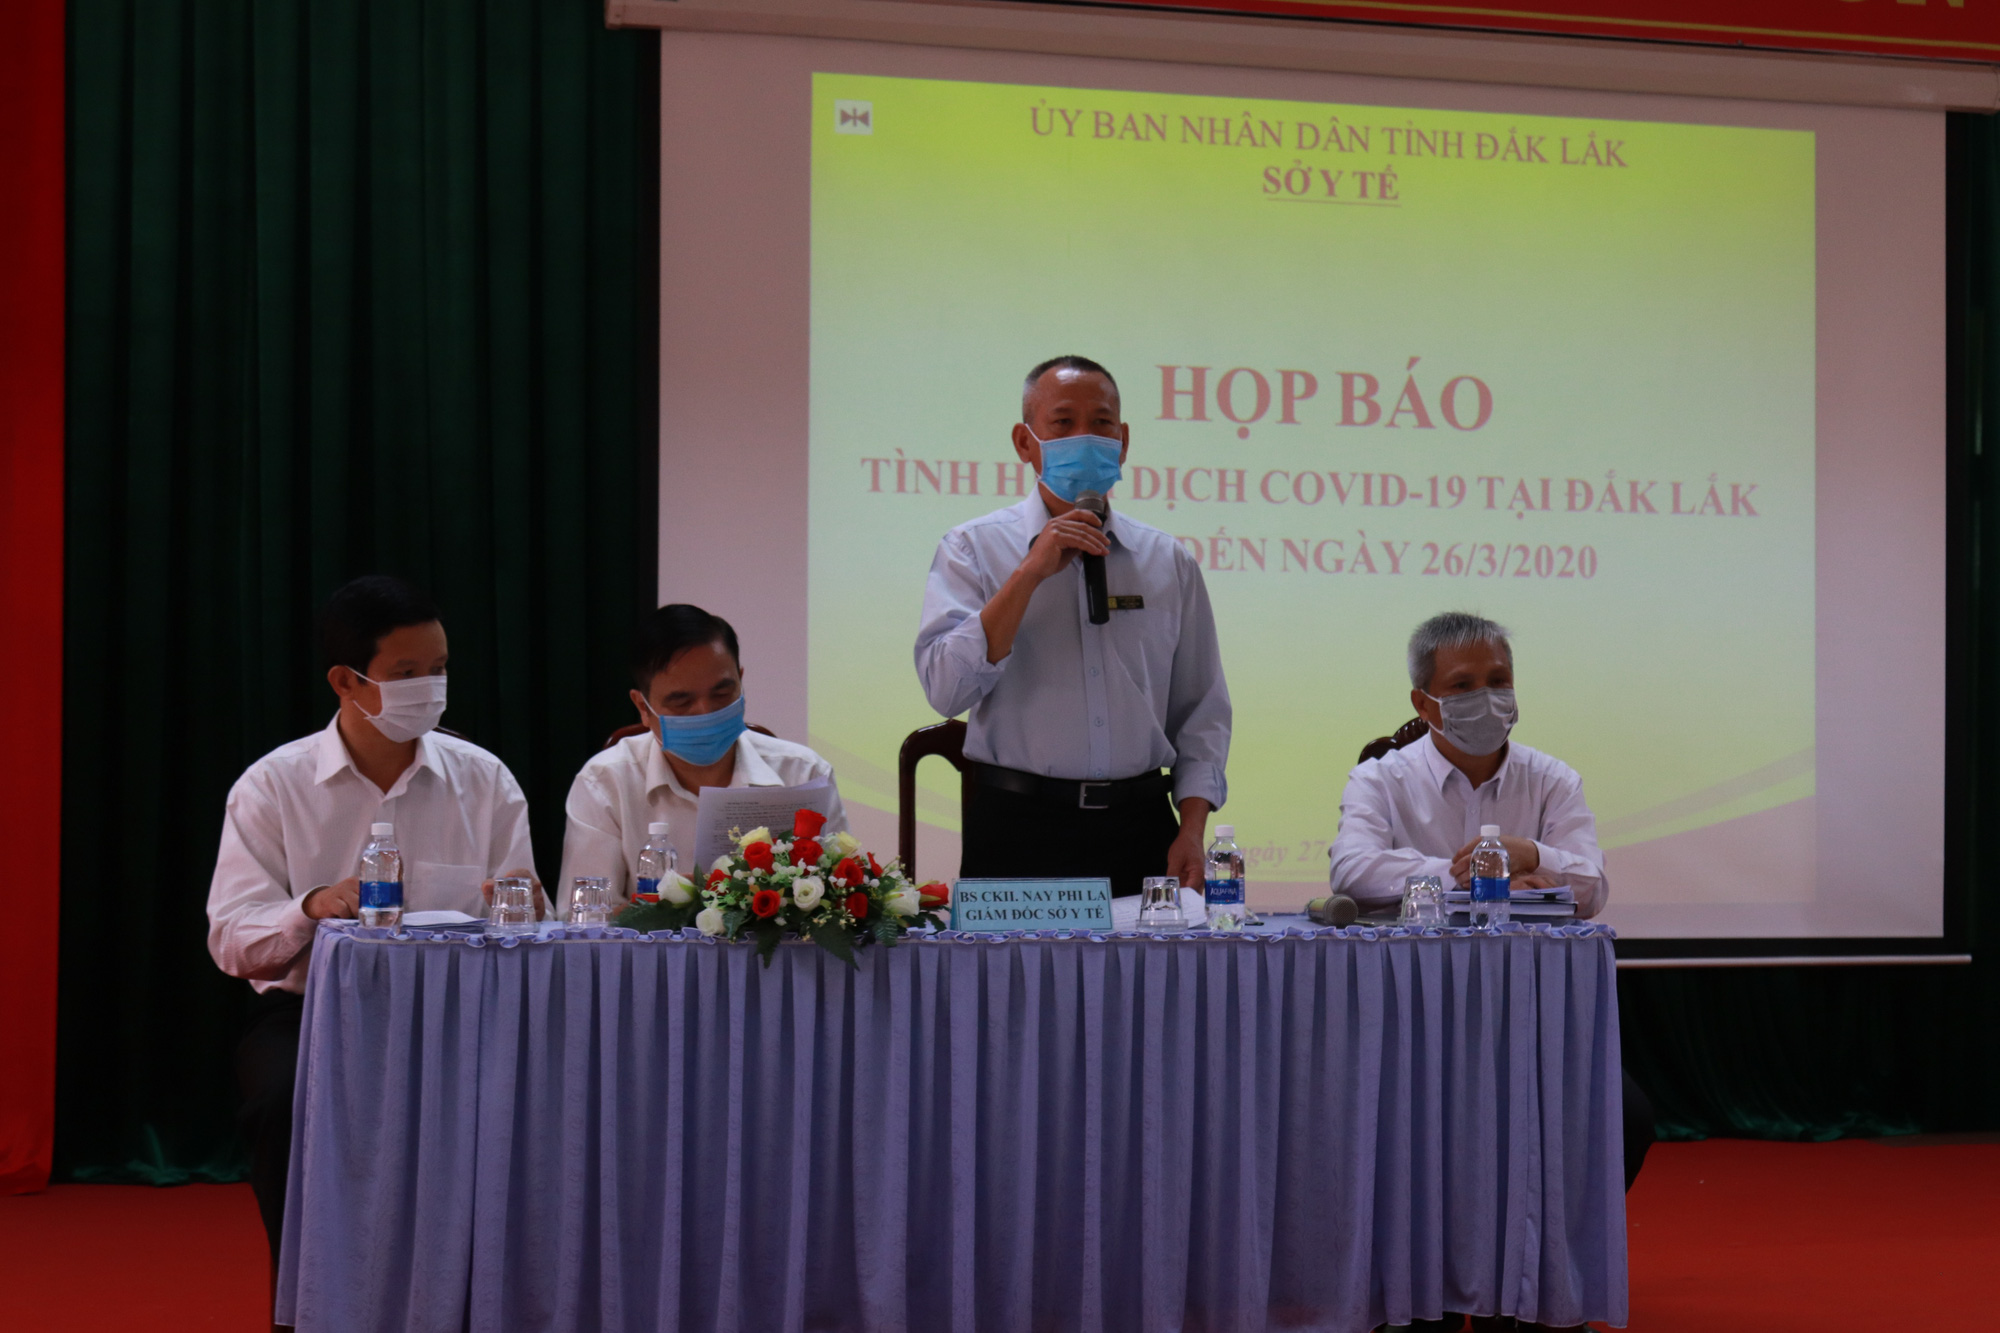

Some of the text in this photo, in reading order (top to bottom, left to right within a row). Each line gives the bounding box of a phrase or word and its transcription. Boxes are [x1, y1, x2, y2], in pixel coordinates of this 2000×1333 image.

[1030, 99, 1629, 168] ỦY BAN NHÂN DÂN TỈNH ĐẮK LẮK
[1262, 159, 1399, 200] SỞ Y TẾ
[1155, 356, 1494, 440] HỌP BÁO
[860, 448, 980, 496] TÌNH
[1132, 465, 1248, 512] DỊCH
[1259, 470, 1467, 509] COVID-19
[1477, 475, 1551, 520] TẠI
[1564, 469, 1659, 514] ĐẮK
[1670, 472, 1760, 517] LẮK
[1281, 530, 1410, 575] NGÀY
[1421, 541, 1598, 579] 26/3/2020
[960, 891, 977, 903] BS
[1023, 890, 1053, 902] NAY
[1058, 890, 1083, 901] PHI
[1088, 890, 1107, 901] LA
[966, 905, 1104, 921] GIÁM ĐỐC SỞ Y TẾ
[1210, 887, 1237, 897] AQUAFINA
